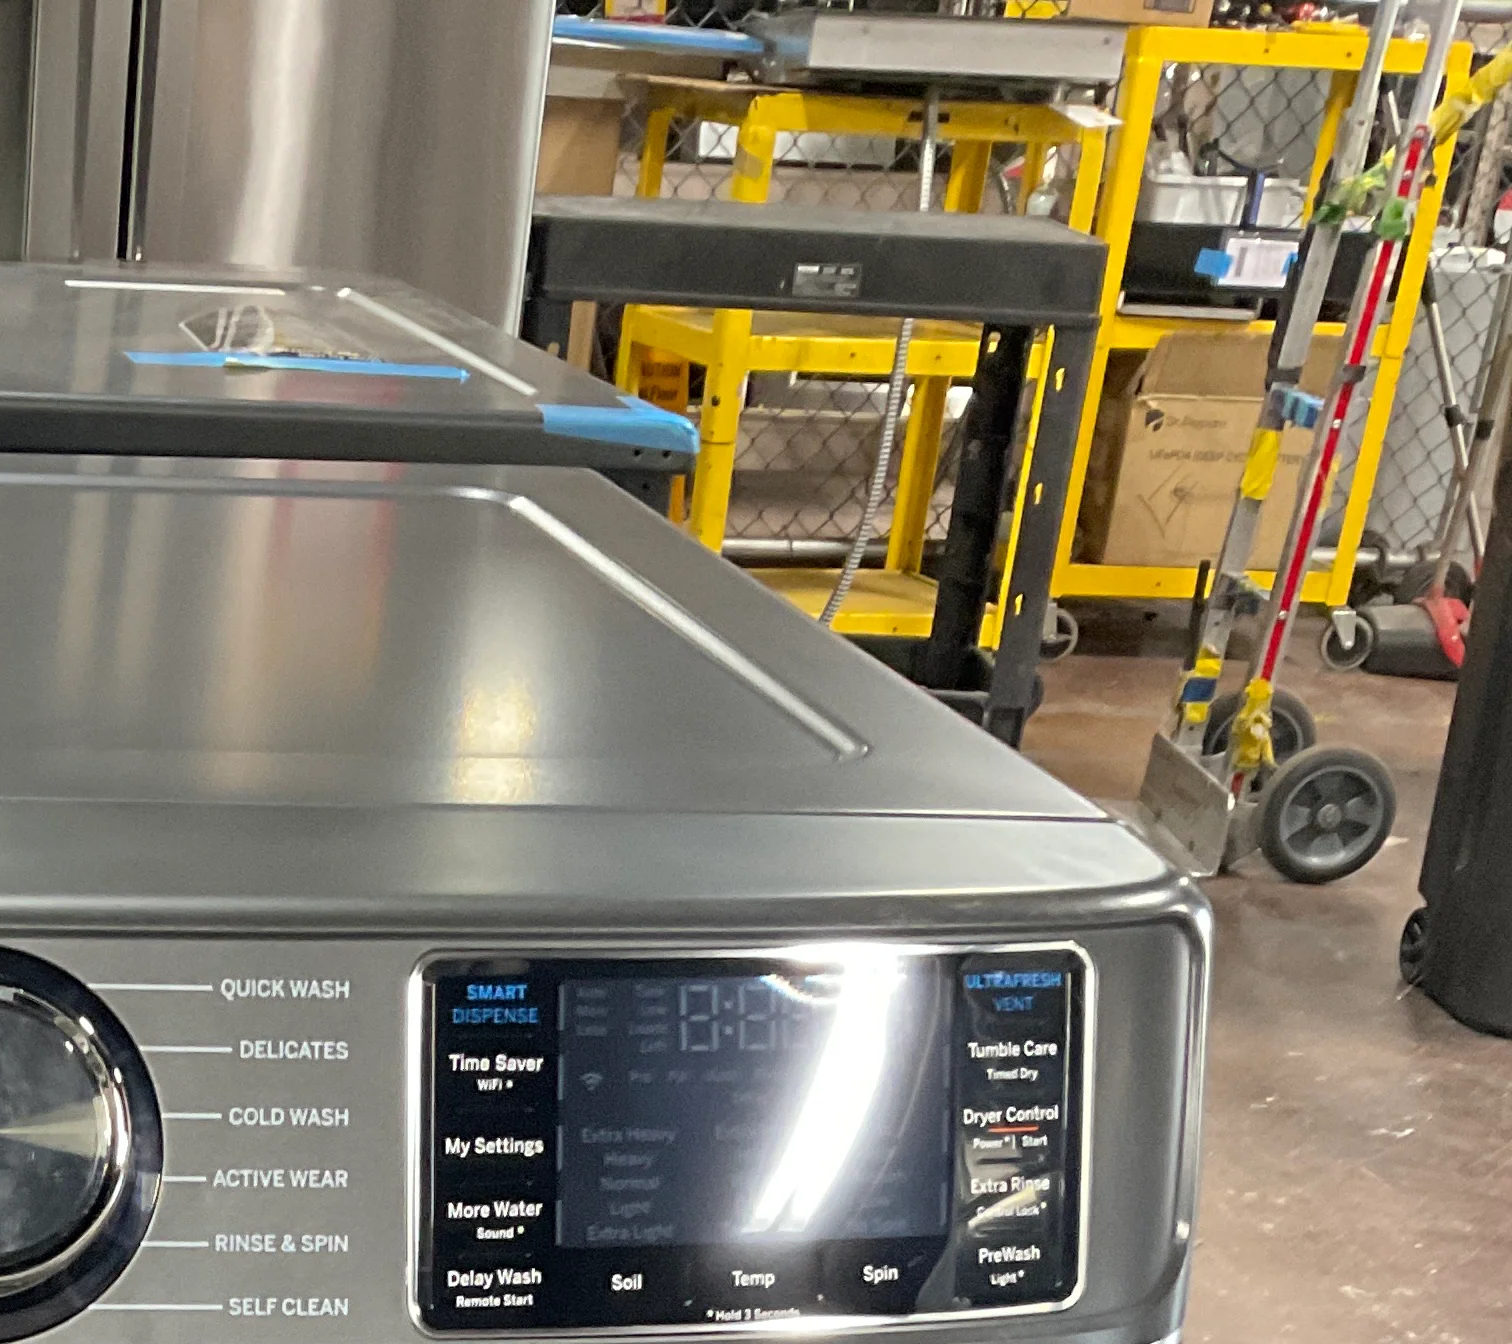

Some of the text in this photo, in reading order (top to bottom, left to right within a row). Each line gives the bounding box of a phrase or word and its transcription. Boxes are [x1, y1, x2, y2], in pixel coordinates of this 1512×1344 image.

[220, 979, 351, 1000] QUICK WASH
[963, 971, 1062, 990] ULTRAFRESH
[466, 983, 528, 1001] SMART
[991, 996, 1035, 1012] VENT
[451, 1006, 539, 1025] DISPENSE
[239, 1040, 350, 1060] DELICATES
[968, 1041, 1058, 1059] Tumble Care
[448, 1053, 544, 1073] Time Saver
[987, 1067, 1039, 1082] Timed Dry
[228, 1107, 350, 1127] COLD WASH
[963, 1105, 1059, 1127] Dryer Control
[444, 1137, 545, 1158] My Settings
[213, 1170, 349, 1189] ACTIVE WEAR
[970, 1176, 1050, 1194] Extra Rinse
[447, 1200, 543, 1219] More Water
[215, 1234, 349, 1253] RINSE & SPIN
[978, 1246, 1041, 1264] PreWash
[447, 1268, 542, 1290] Delay Wash
[610, 1273, 644, 1291] Soil
[731, 1270, 776, 1289] Temp
[862, 1265, 899, 1285] Spin
[228, 1297, 349, 1317] SELF CLEAN
[455, 1293, 534, 1308] Remote Start
